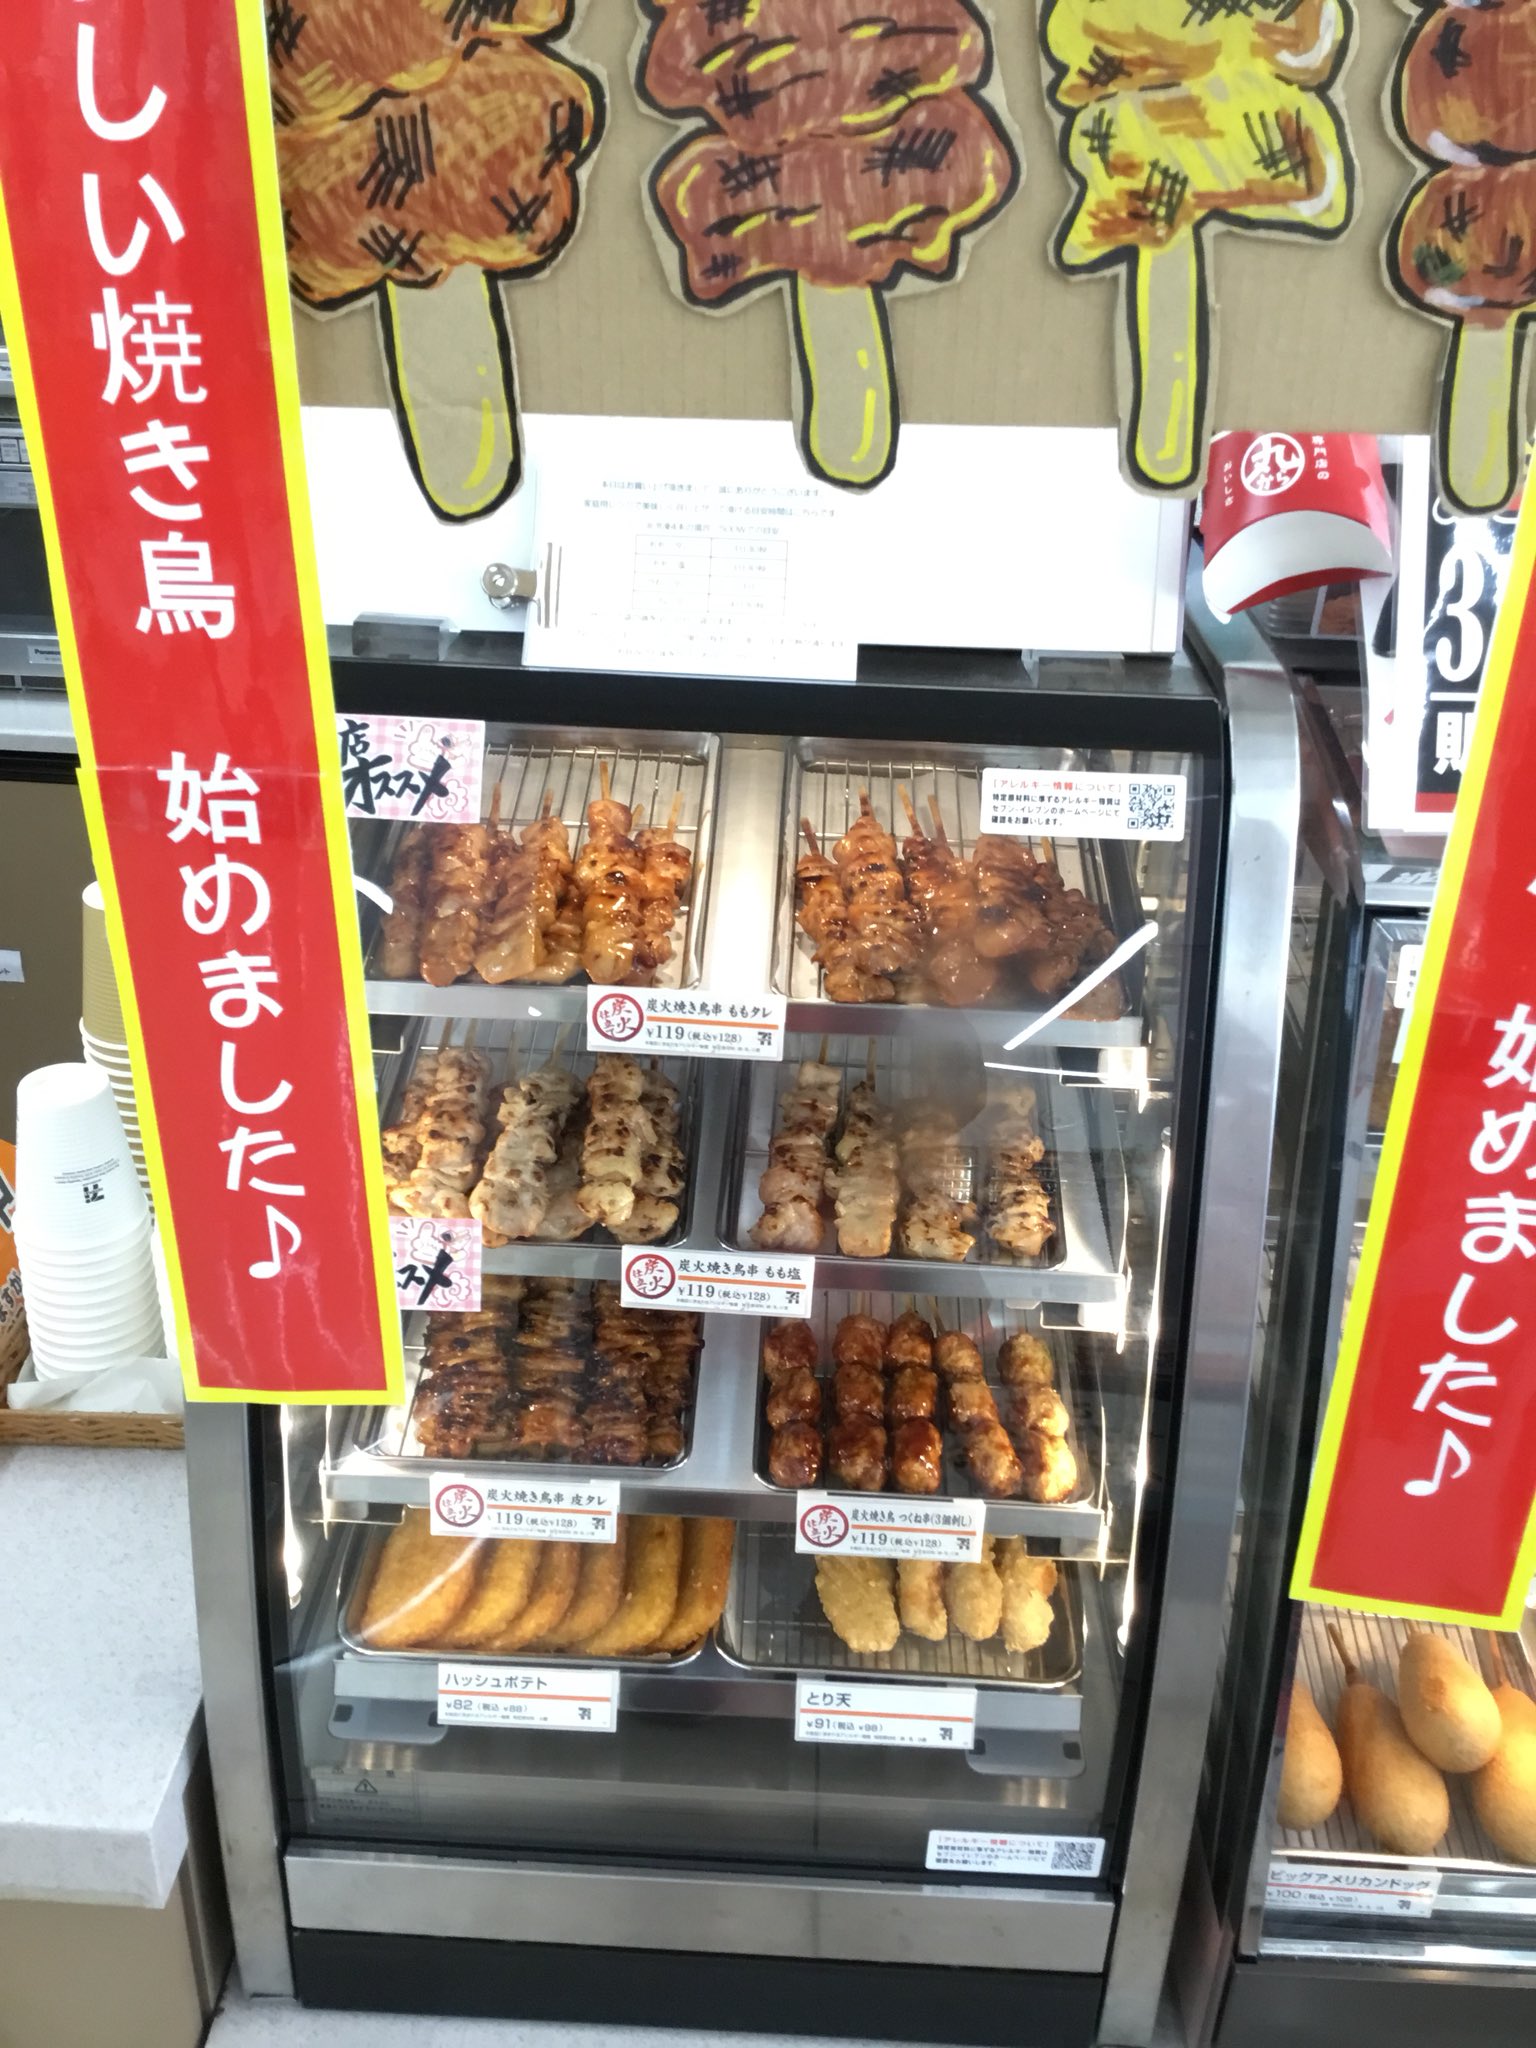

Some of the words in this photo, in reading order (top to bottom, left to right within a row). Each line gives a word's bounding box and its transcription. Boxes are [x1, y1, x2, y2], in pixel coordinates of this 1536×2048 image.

[342, 754, 452, 816] オススメ
[646, 998, 722, 1016] 炭火焼き鳥串
[729, 1005, 772, 1019] ももタレ
[396, 1249, 454, 1305] スメ
[678, 1258, 759, 1276] 炭火焼き鳥串
[765, 1266, 802, 1281] もも塩
[486, 1488, 564, 1505] 炭火焼き鳥串
[571, 1493, 607, 1507] 皮タレ
[851, 1508, 896, 1524] 炭火焼き鳥
[445, 1673, 548, 1691] ハッシュポテト
[806, 1691, 852, 1708] とり天
[1269, 1870, 1431, 1890] ビッグアメリカンドッグ
